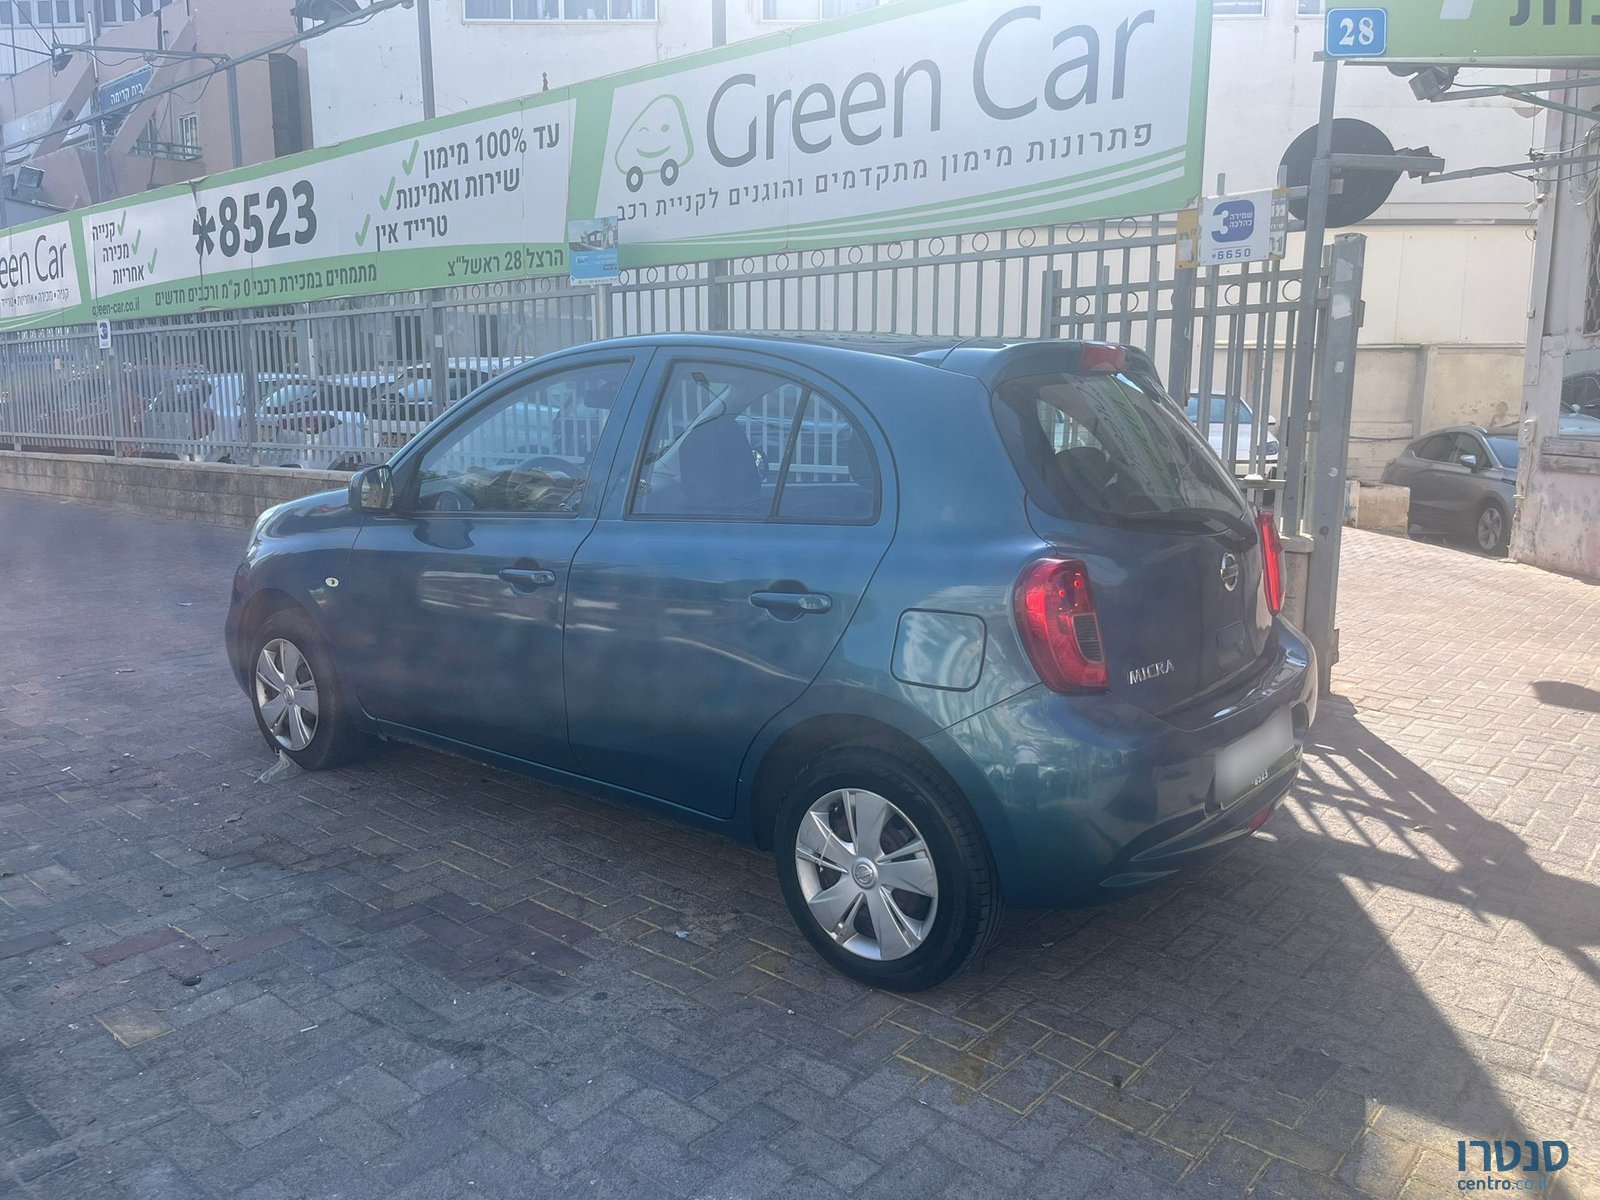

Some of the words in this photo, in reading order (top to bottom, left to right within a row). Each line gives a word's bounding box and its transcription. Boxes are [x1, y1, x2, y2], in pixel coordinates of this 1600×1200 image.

[1339, 17, 1375, 47] 28
[705, 59, 942, 168] Green
[972, 5, 1156, 121] Car
[475, 127, 527, 161] 100%
[533, 123, 561, 150] עד
[1026, 122, 1153, 164] פתרונות
[424, 143, 470, 178] מימון
[940, 146, 1013, 181] מימון
[465, 167, 520, 199] שירות
[815, 158, 928, 194] מתקדמים
[396, 178, 460, 211] ואמינות
[655, 187, 719, 218] לקניית
[729, 174, 803, 207] והוגנים
[617, 200, 648, 222] רכב
[1229, 211, 1253, 220] שמירה
[92, 222, 116, 242] קנייה
[375, 222, 399, 251] אין
[403, 214, 449, 241] טרייד
[34, 235, 67, 281] Car
[102, 243, 130, 263] מכירה
[504, 251, 523, 271] 28
[525, 248, 564, 271] הרצל
[113, 264, 145, 285] אחריות
[252, 273, 277, 295] רכבי
[278, 268, 323, 292] במכירת
[325, 263, 377, 286] מתמחים
[155, 288, 186, 307] חדשים
[1128, 658, 1175, 685] MICRA
